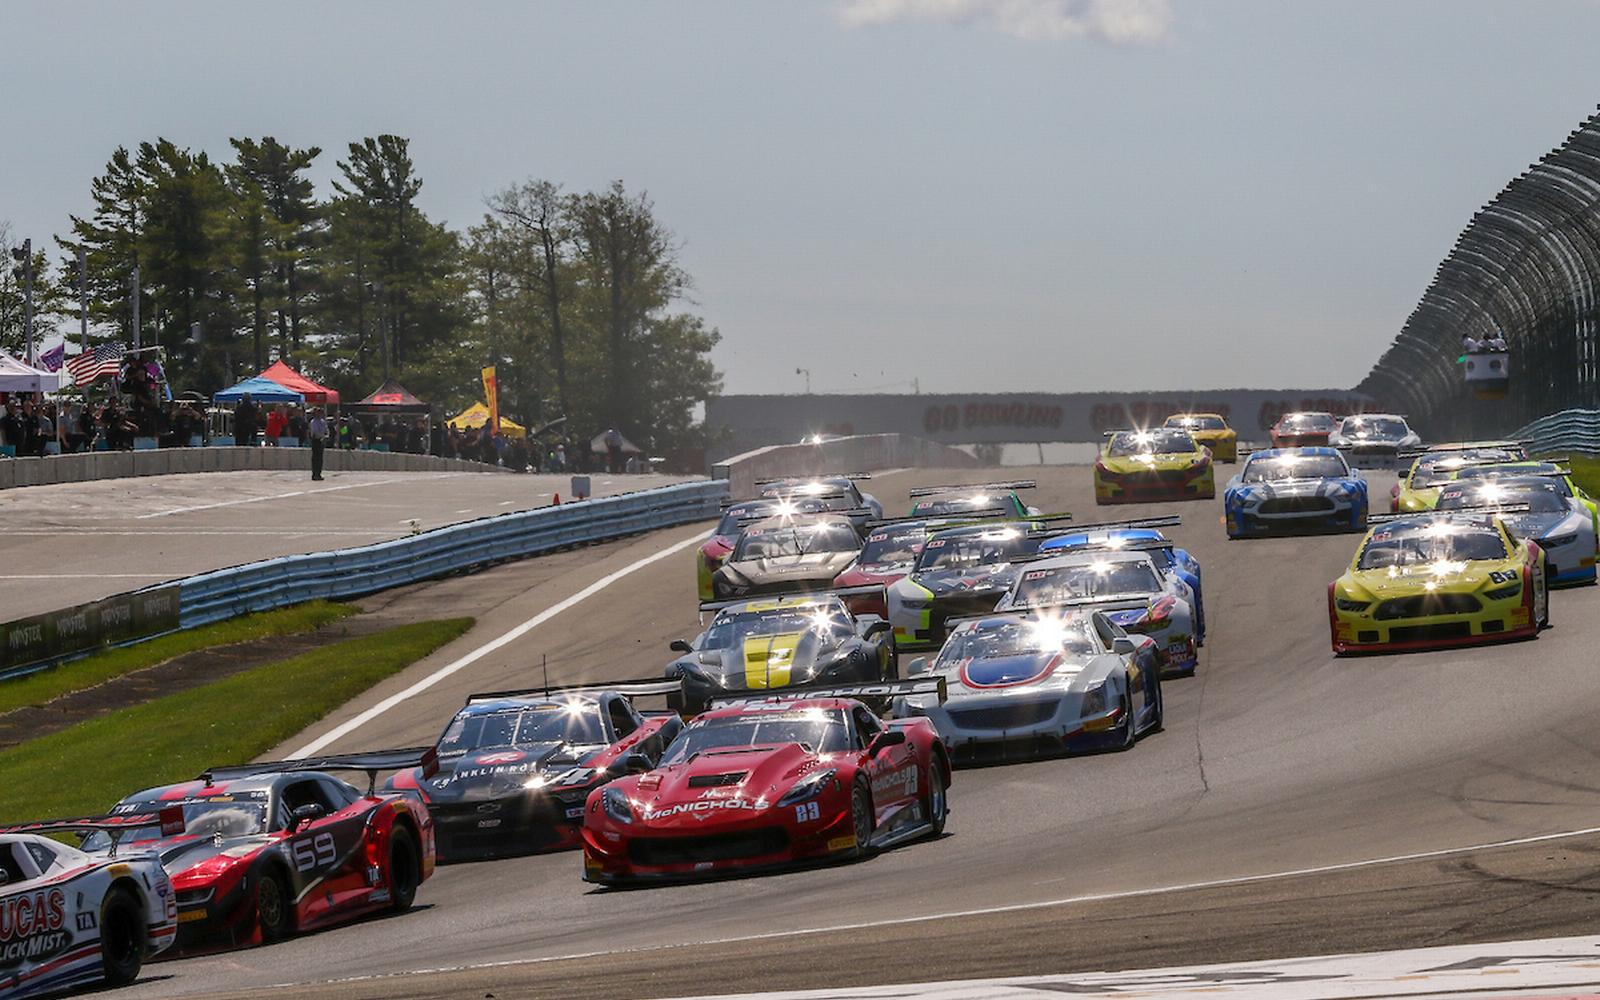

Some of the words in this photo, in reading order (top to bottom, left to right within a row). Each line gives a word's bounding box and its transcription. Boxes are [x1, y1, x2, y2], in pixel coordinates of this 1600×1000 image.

[432, 767, 506, 789] FRANKLIN
[293, 832, 336, 872] 59
[0, 889, 64, 941] UCAS
[77, 913, 94, 929] TA
[0, 941, 28, 960] ICK
[27, 932, 64, 956] MIST
